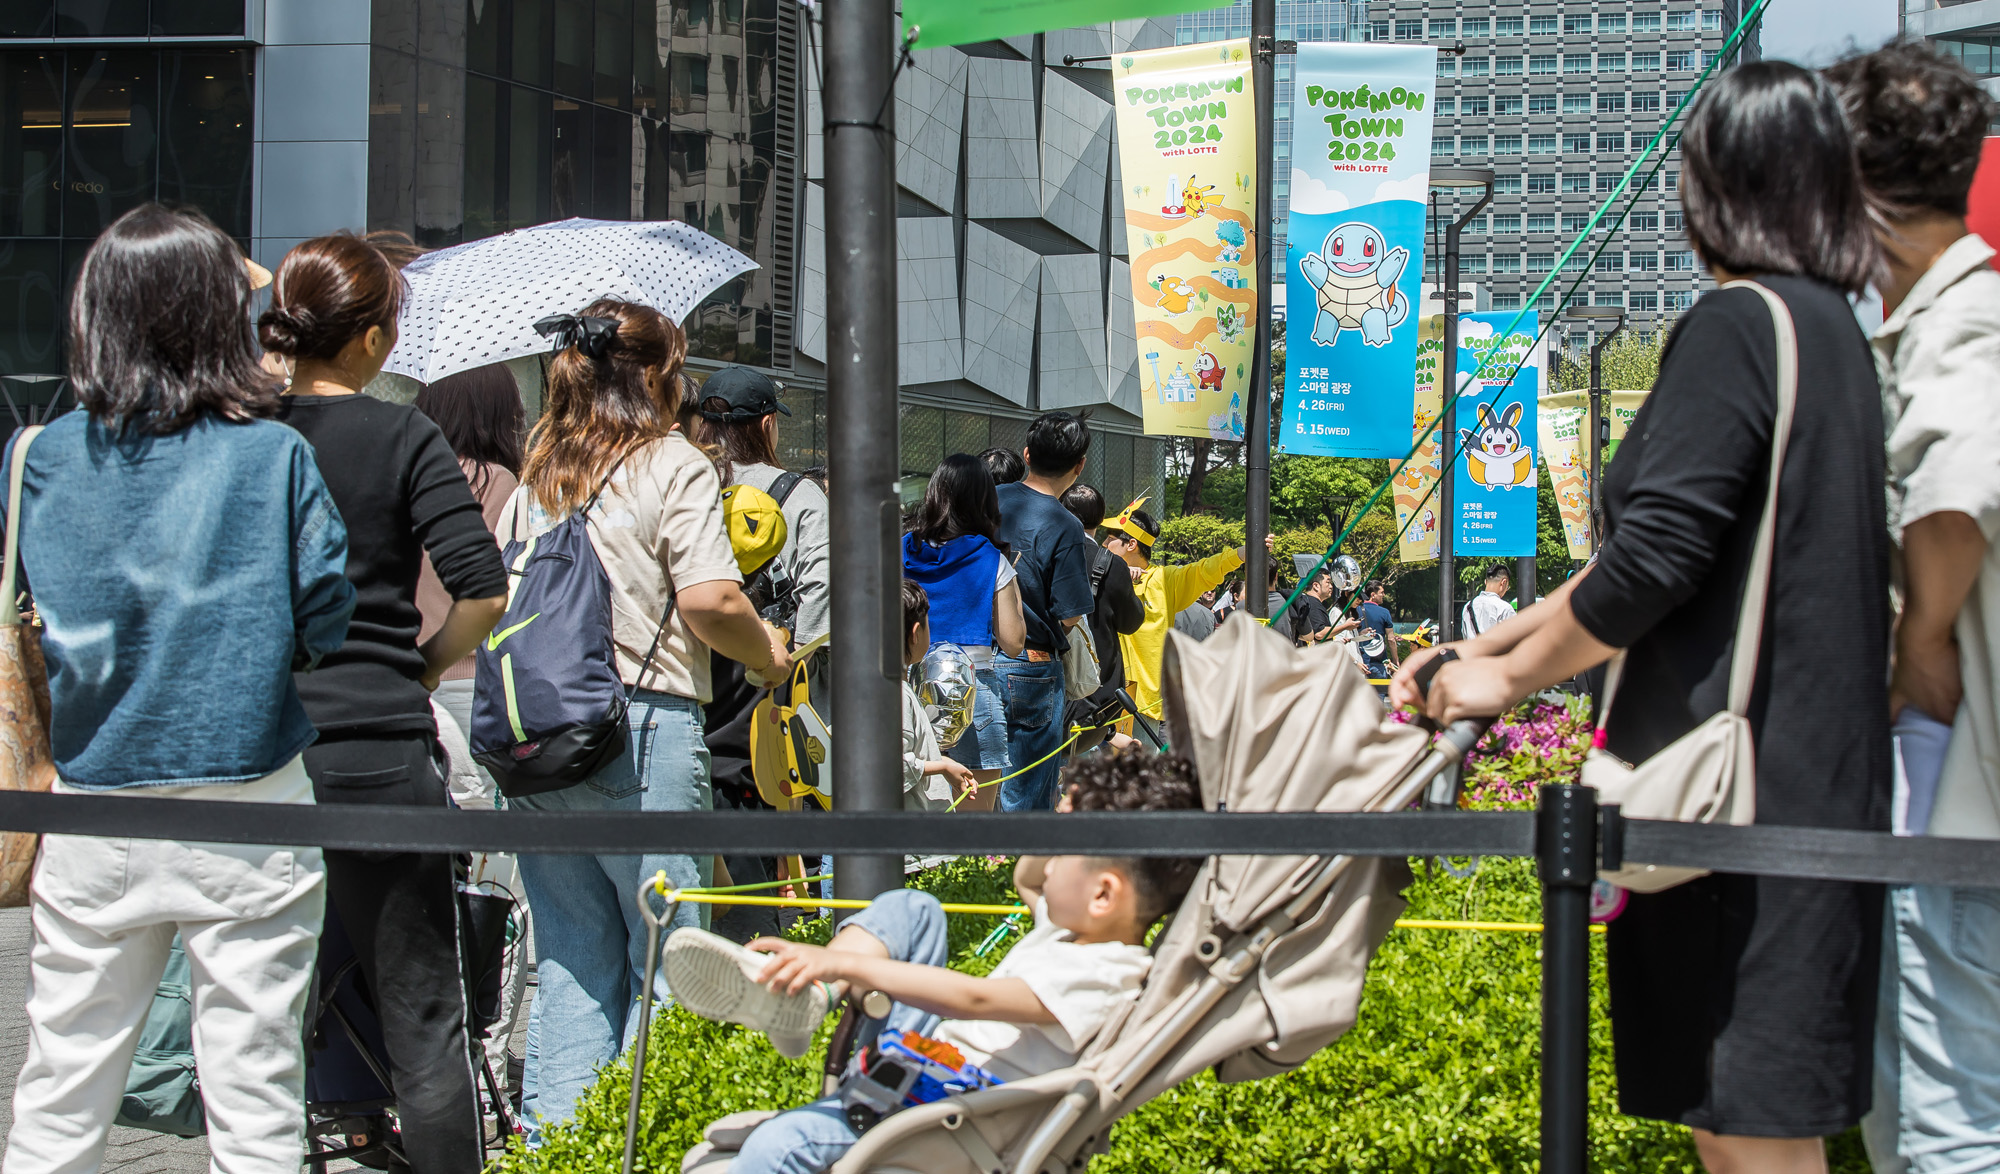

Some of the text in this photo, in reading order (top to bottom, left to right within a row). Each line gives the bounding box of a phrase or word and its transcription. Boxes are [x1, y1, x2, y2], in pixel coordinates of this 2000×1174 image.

[1305, 84, 1425, 113] POKÉMON
[1146, 101, 1227, 127] TOWN
[1324, 113, 1404, 139] TOWN
[1154, 124, 1223, 148] 2024
[1162, 146, 1218, 157] with LOTTE
[1328, 141, 1396, 161] 2024
[1334, 163, 1389, 173] with LOTTE
[1299, 367, 1330, 379] 포켓몬
[1477, 366, 1518, 379] 2024
[1298, 382, 1352, 395] 스마일 광장
[1462, 502, 1483, 510] 포켓몬
[1462, 511, 1482, 519] 스마일
